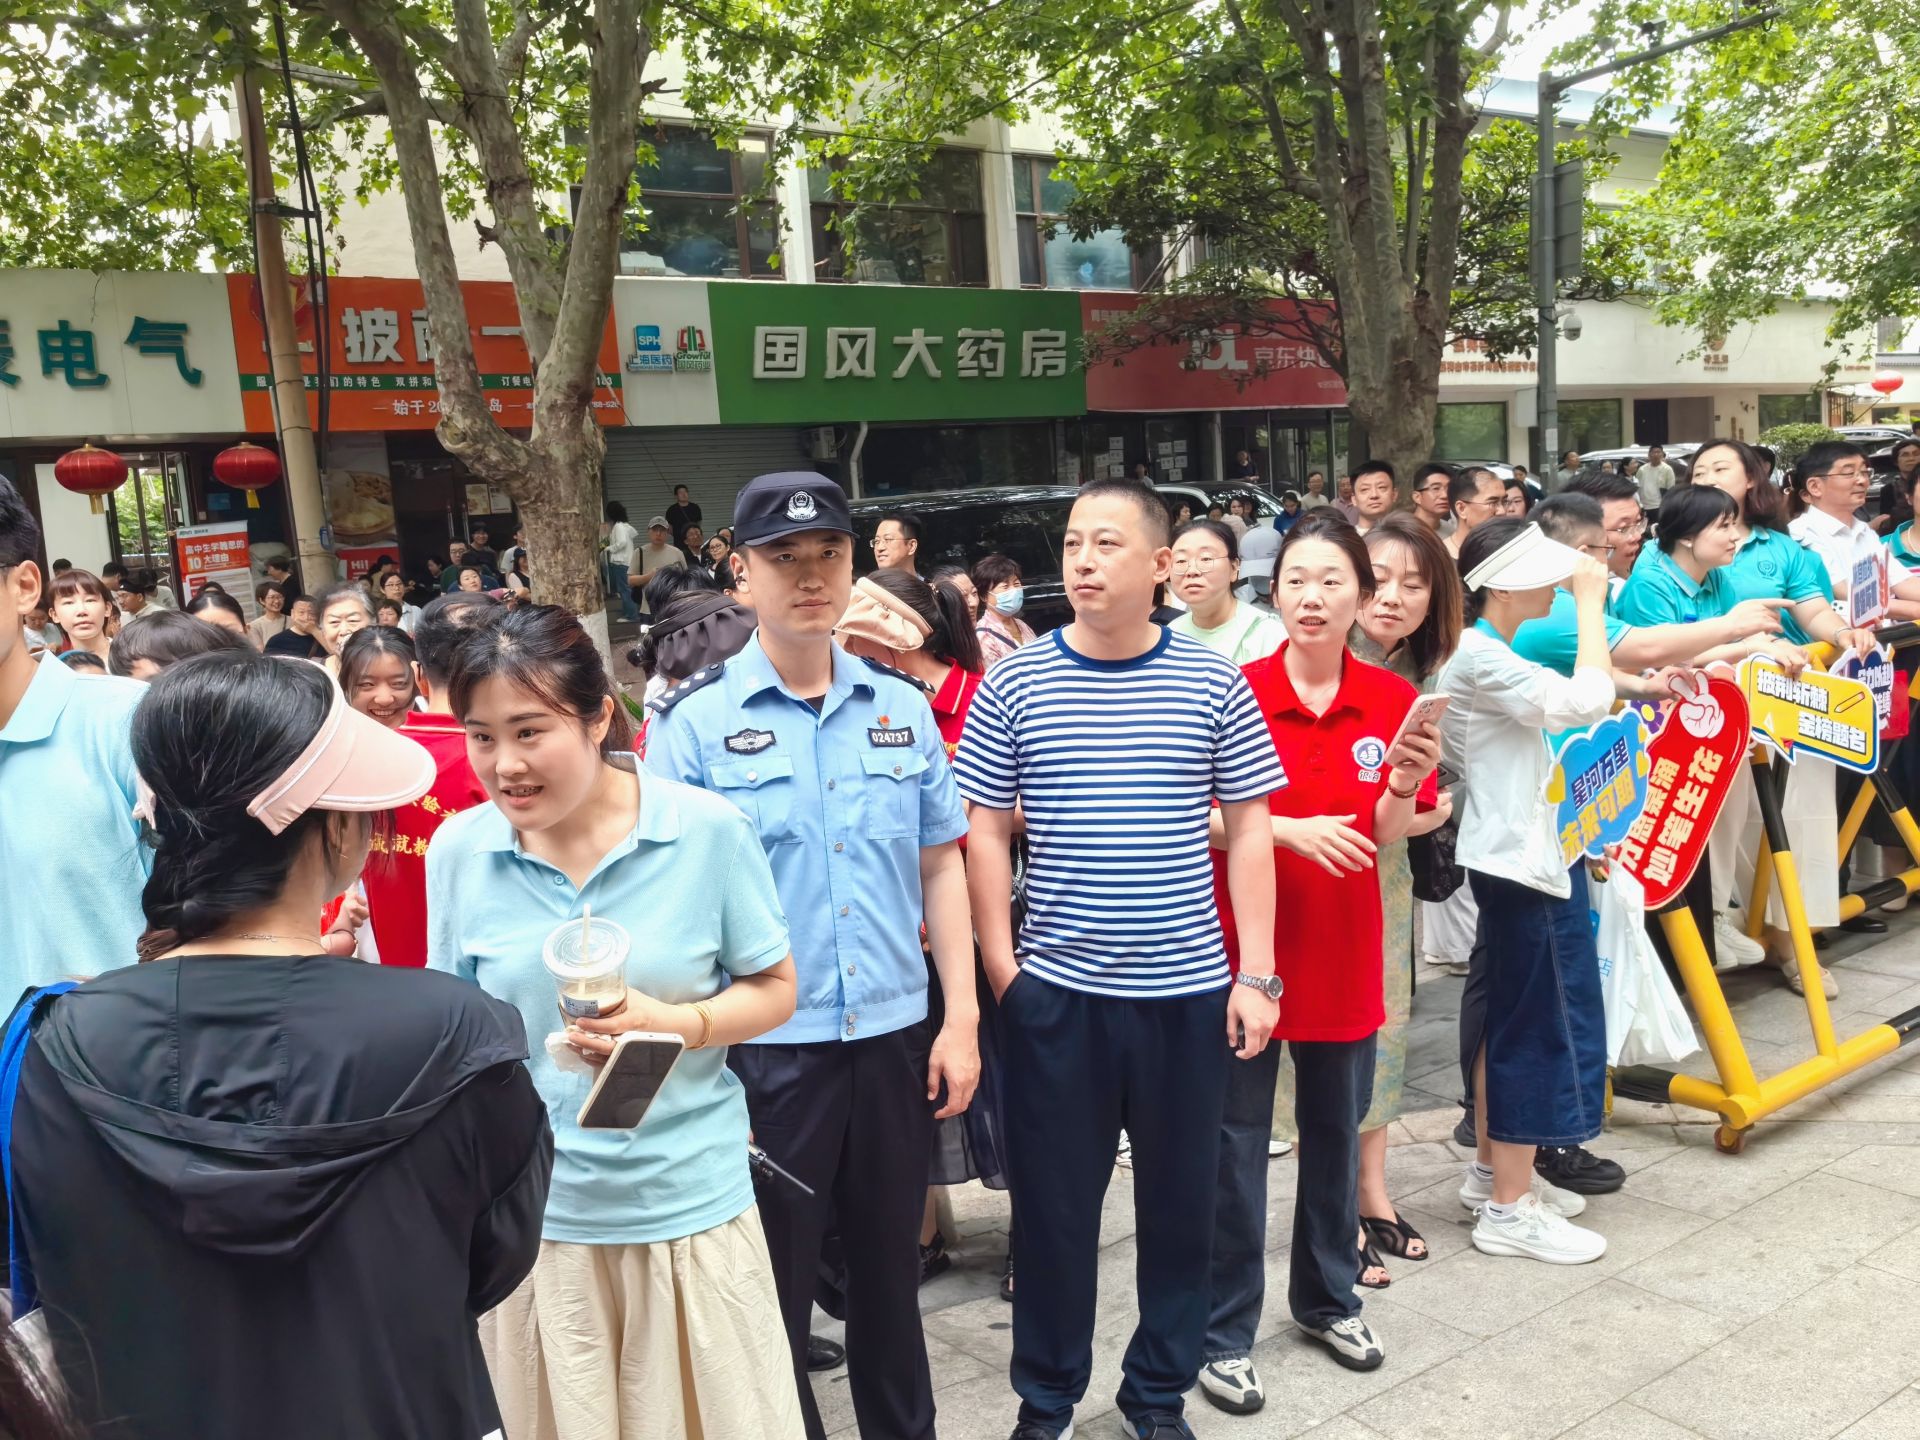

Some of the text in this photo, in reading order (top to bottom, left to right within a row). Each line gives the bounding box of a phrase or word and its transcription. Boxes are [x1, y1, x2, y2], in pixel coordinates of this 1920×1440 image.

[638, 335, 661, 346] SPH
[676, 351, 711, 360] Growful
[753, 326, 1066, 379] 国风大药房
[1757, 669, 1829, 714] 披荆斩棘
[871, 730, 910, 744] 024737
[1798, 710, 1867, 755] 金榜题名
[1571, 735, 1631, 811] 星河万里
[1560, 766, 1637, 866] 未来可期
[1642, 745, 1724, 887] 妙笔生花
